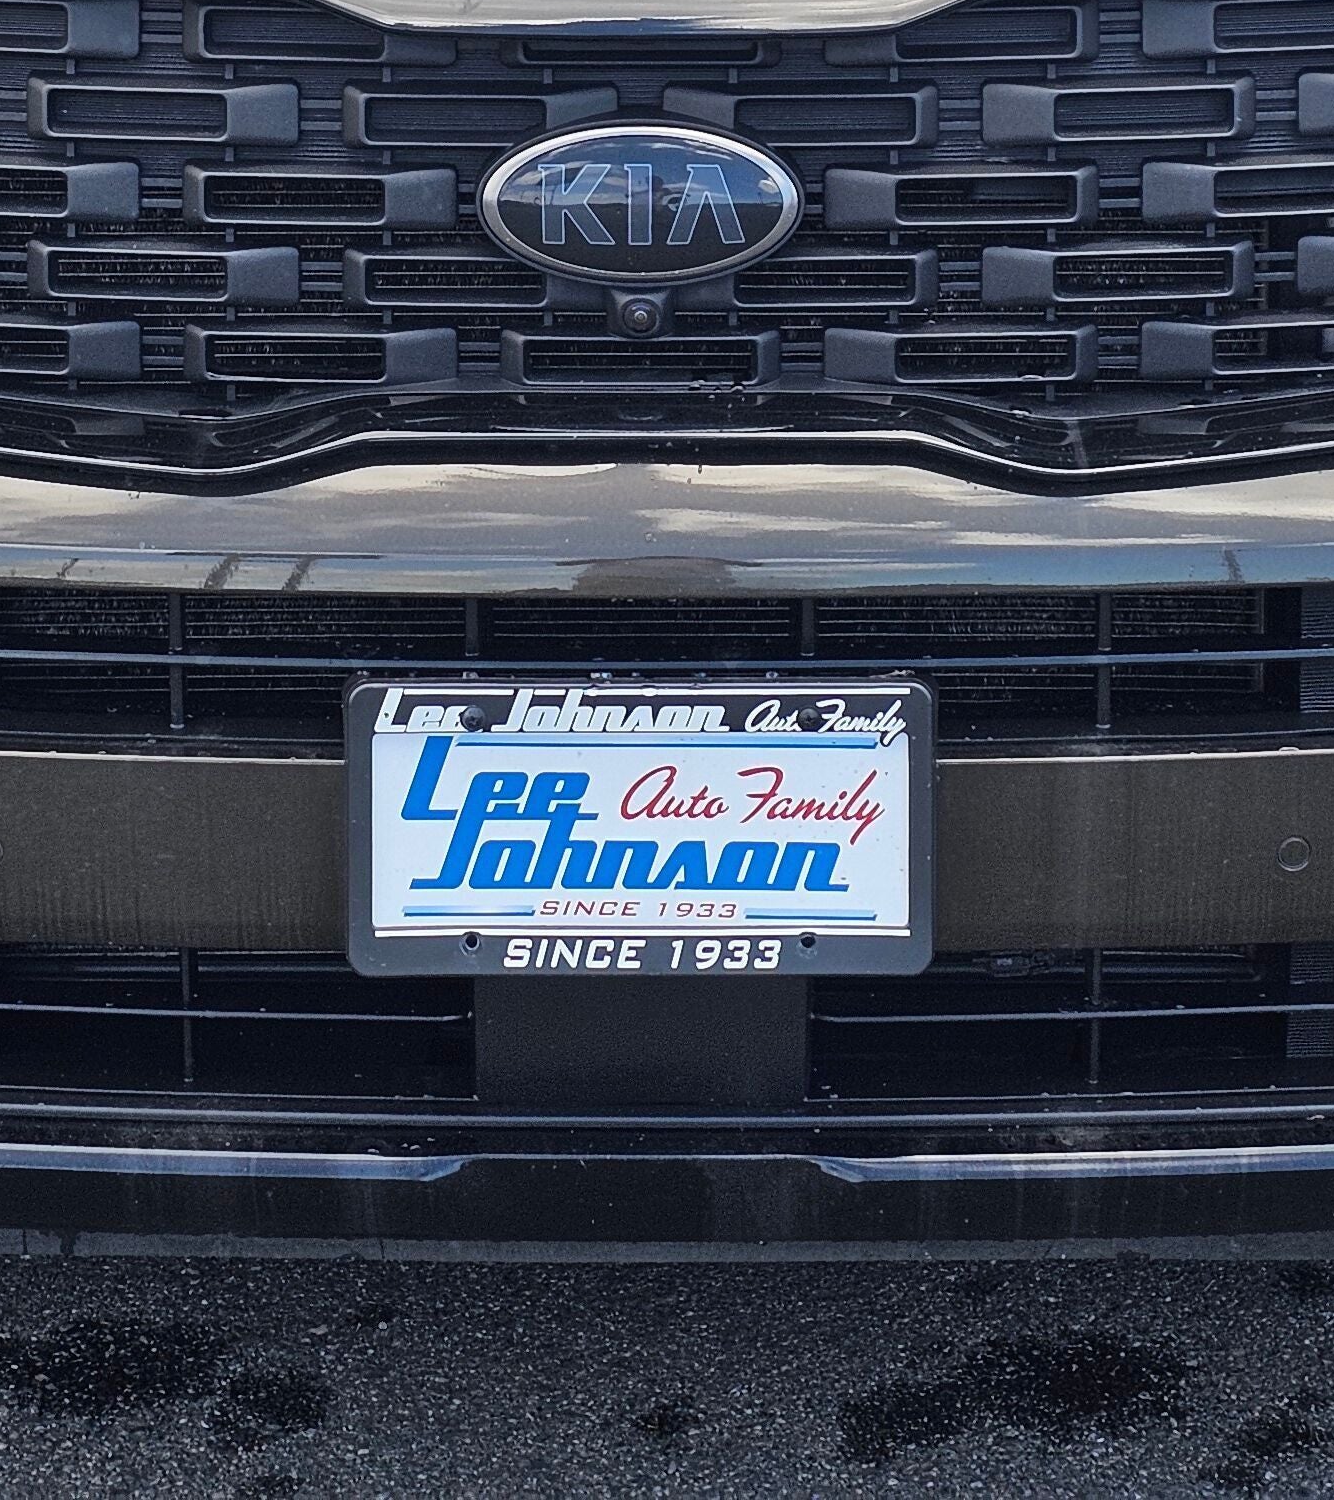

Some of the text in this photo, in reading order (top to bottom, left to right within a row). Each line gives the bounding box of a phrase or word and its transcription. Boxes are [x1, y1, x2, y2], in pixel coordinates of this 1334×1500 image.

[537, 163, 746, 246] KIA
[490, 688, 730, 732] Johnson
[745, 699, 815, 733] Aut
[815, 699, 907, 747] Family
[401, 735, 886, 846] Lee Auto Family
[409, 808, 851, 892] Johnson
[540, 900, 737, 919] SINCE 1933
[503, 938, 783, 971] SINCE 1933
